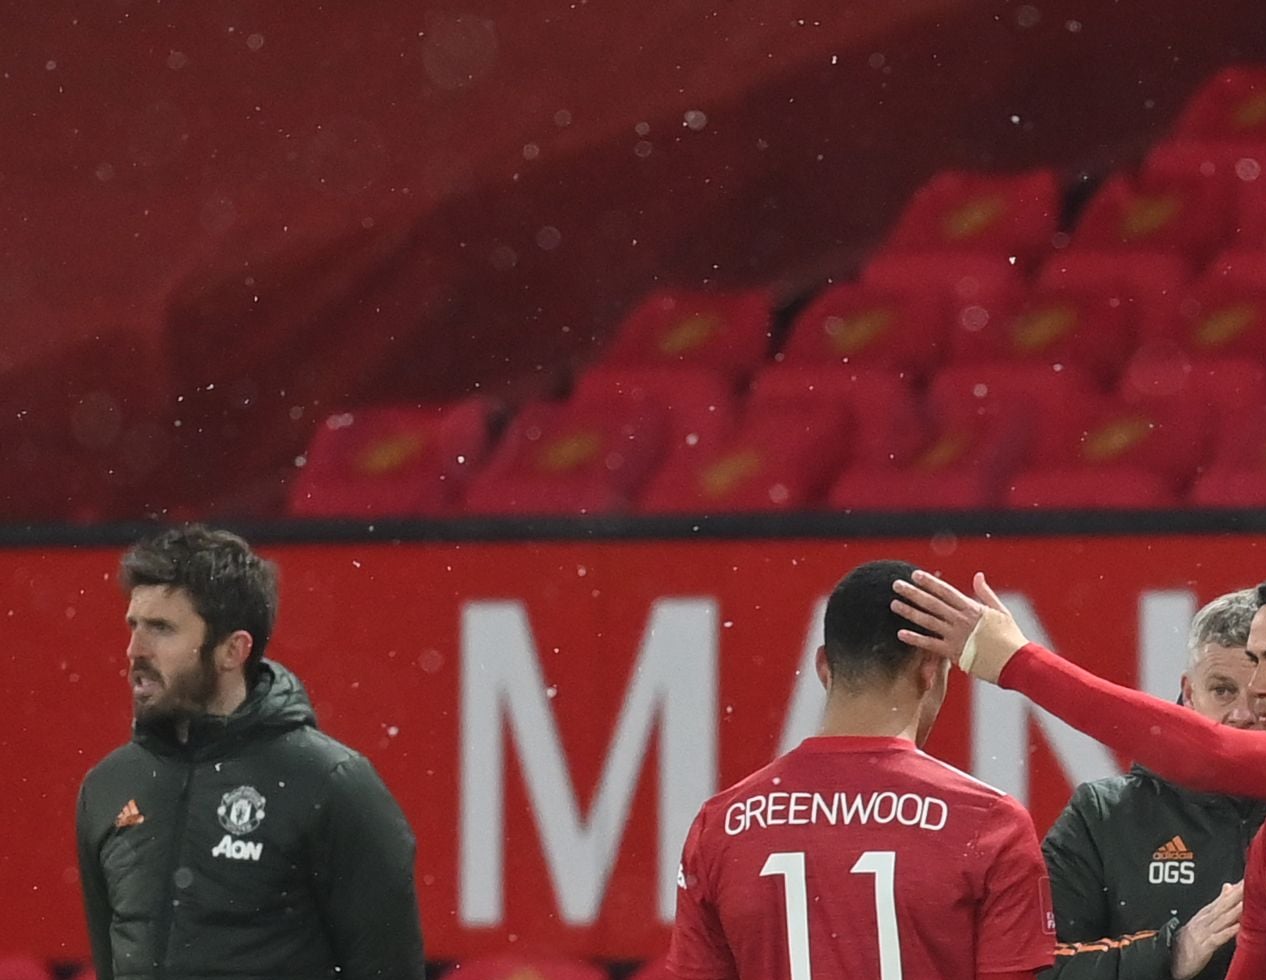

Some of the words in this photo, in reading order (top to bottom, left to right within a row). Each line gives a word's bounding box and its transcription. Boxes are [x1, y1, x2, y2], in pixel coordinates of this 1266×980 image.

[724, 791, 948, 836] GREENWOOD
[211, 834, 264, 861] AON
[1149, 861, 1195, 884] OGS
